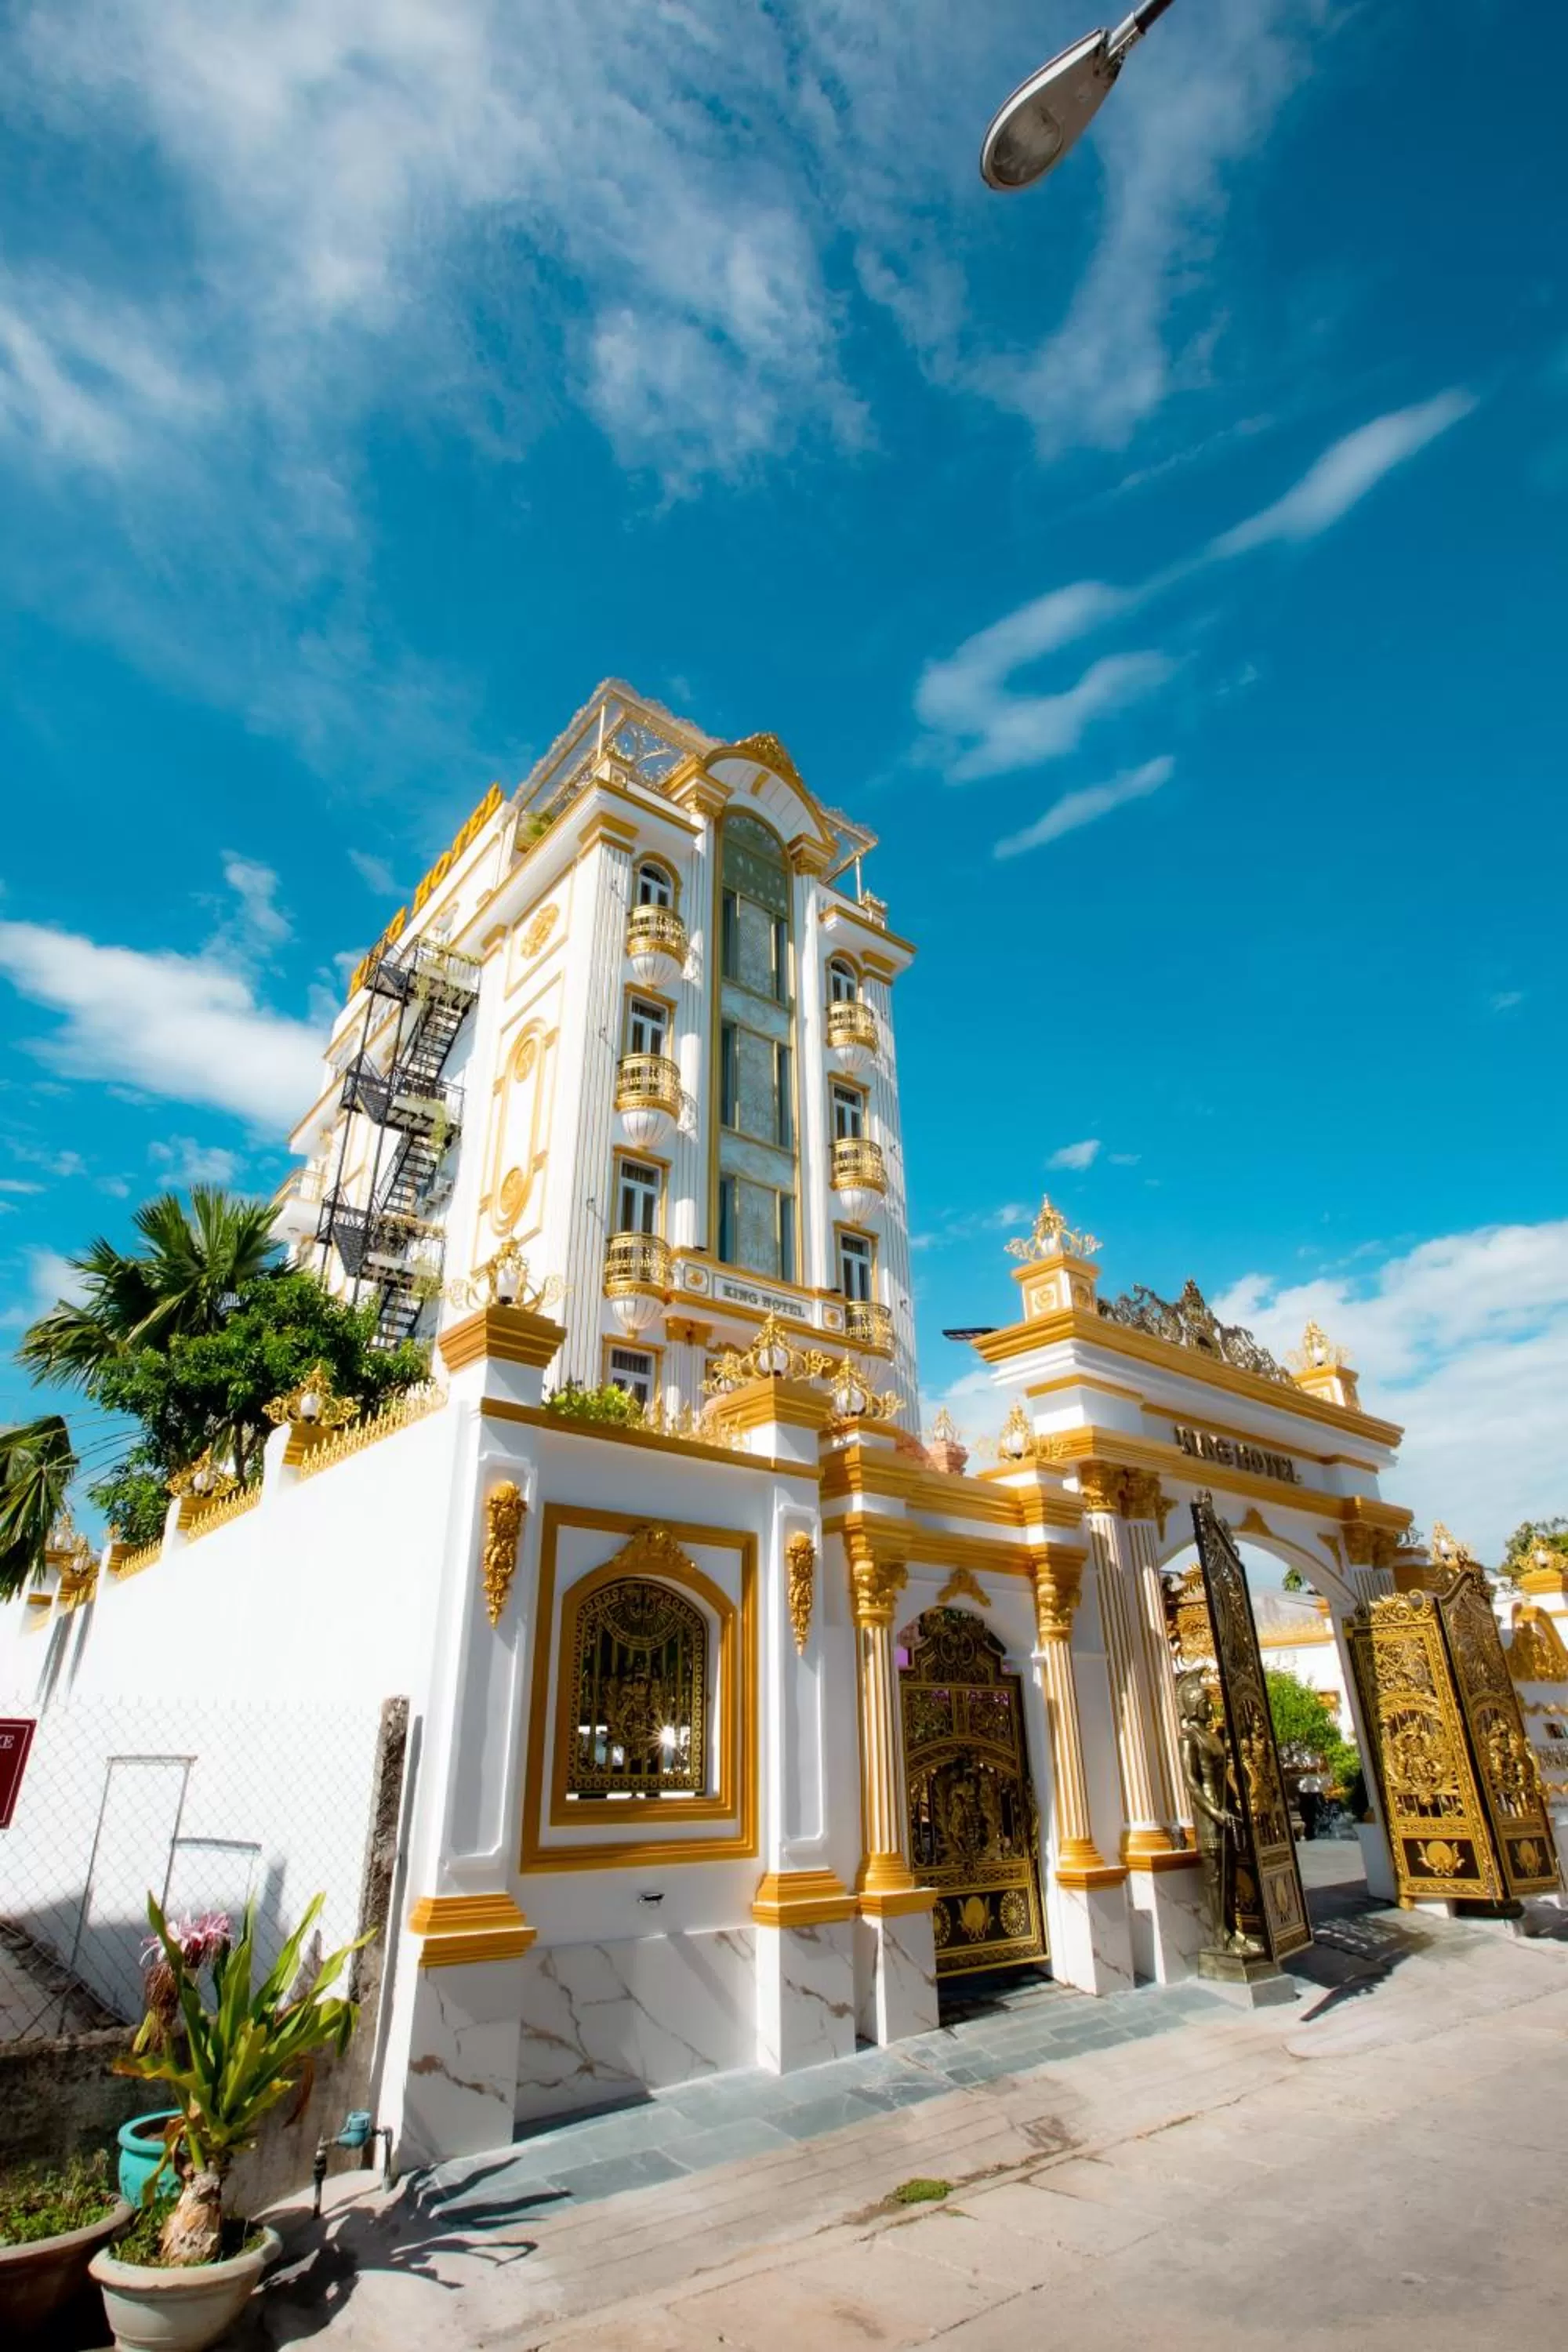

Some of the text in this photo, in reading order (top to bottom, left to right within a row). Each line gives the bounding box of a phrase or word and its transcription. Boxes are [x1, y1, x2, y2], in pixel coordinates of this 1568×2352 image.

[412, 782, 503, 916] HOTEL
[723, 1284, 805, 1318] KING HOTEL
[1174, 1425, 1302, 1485] KING HOTEL
